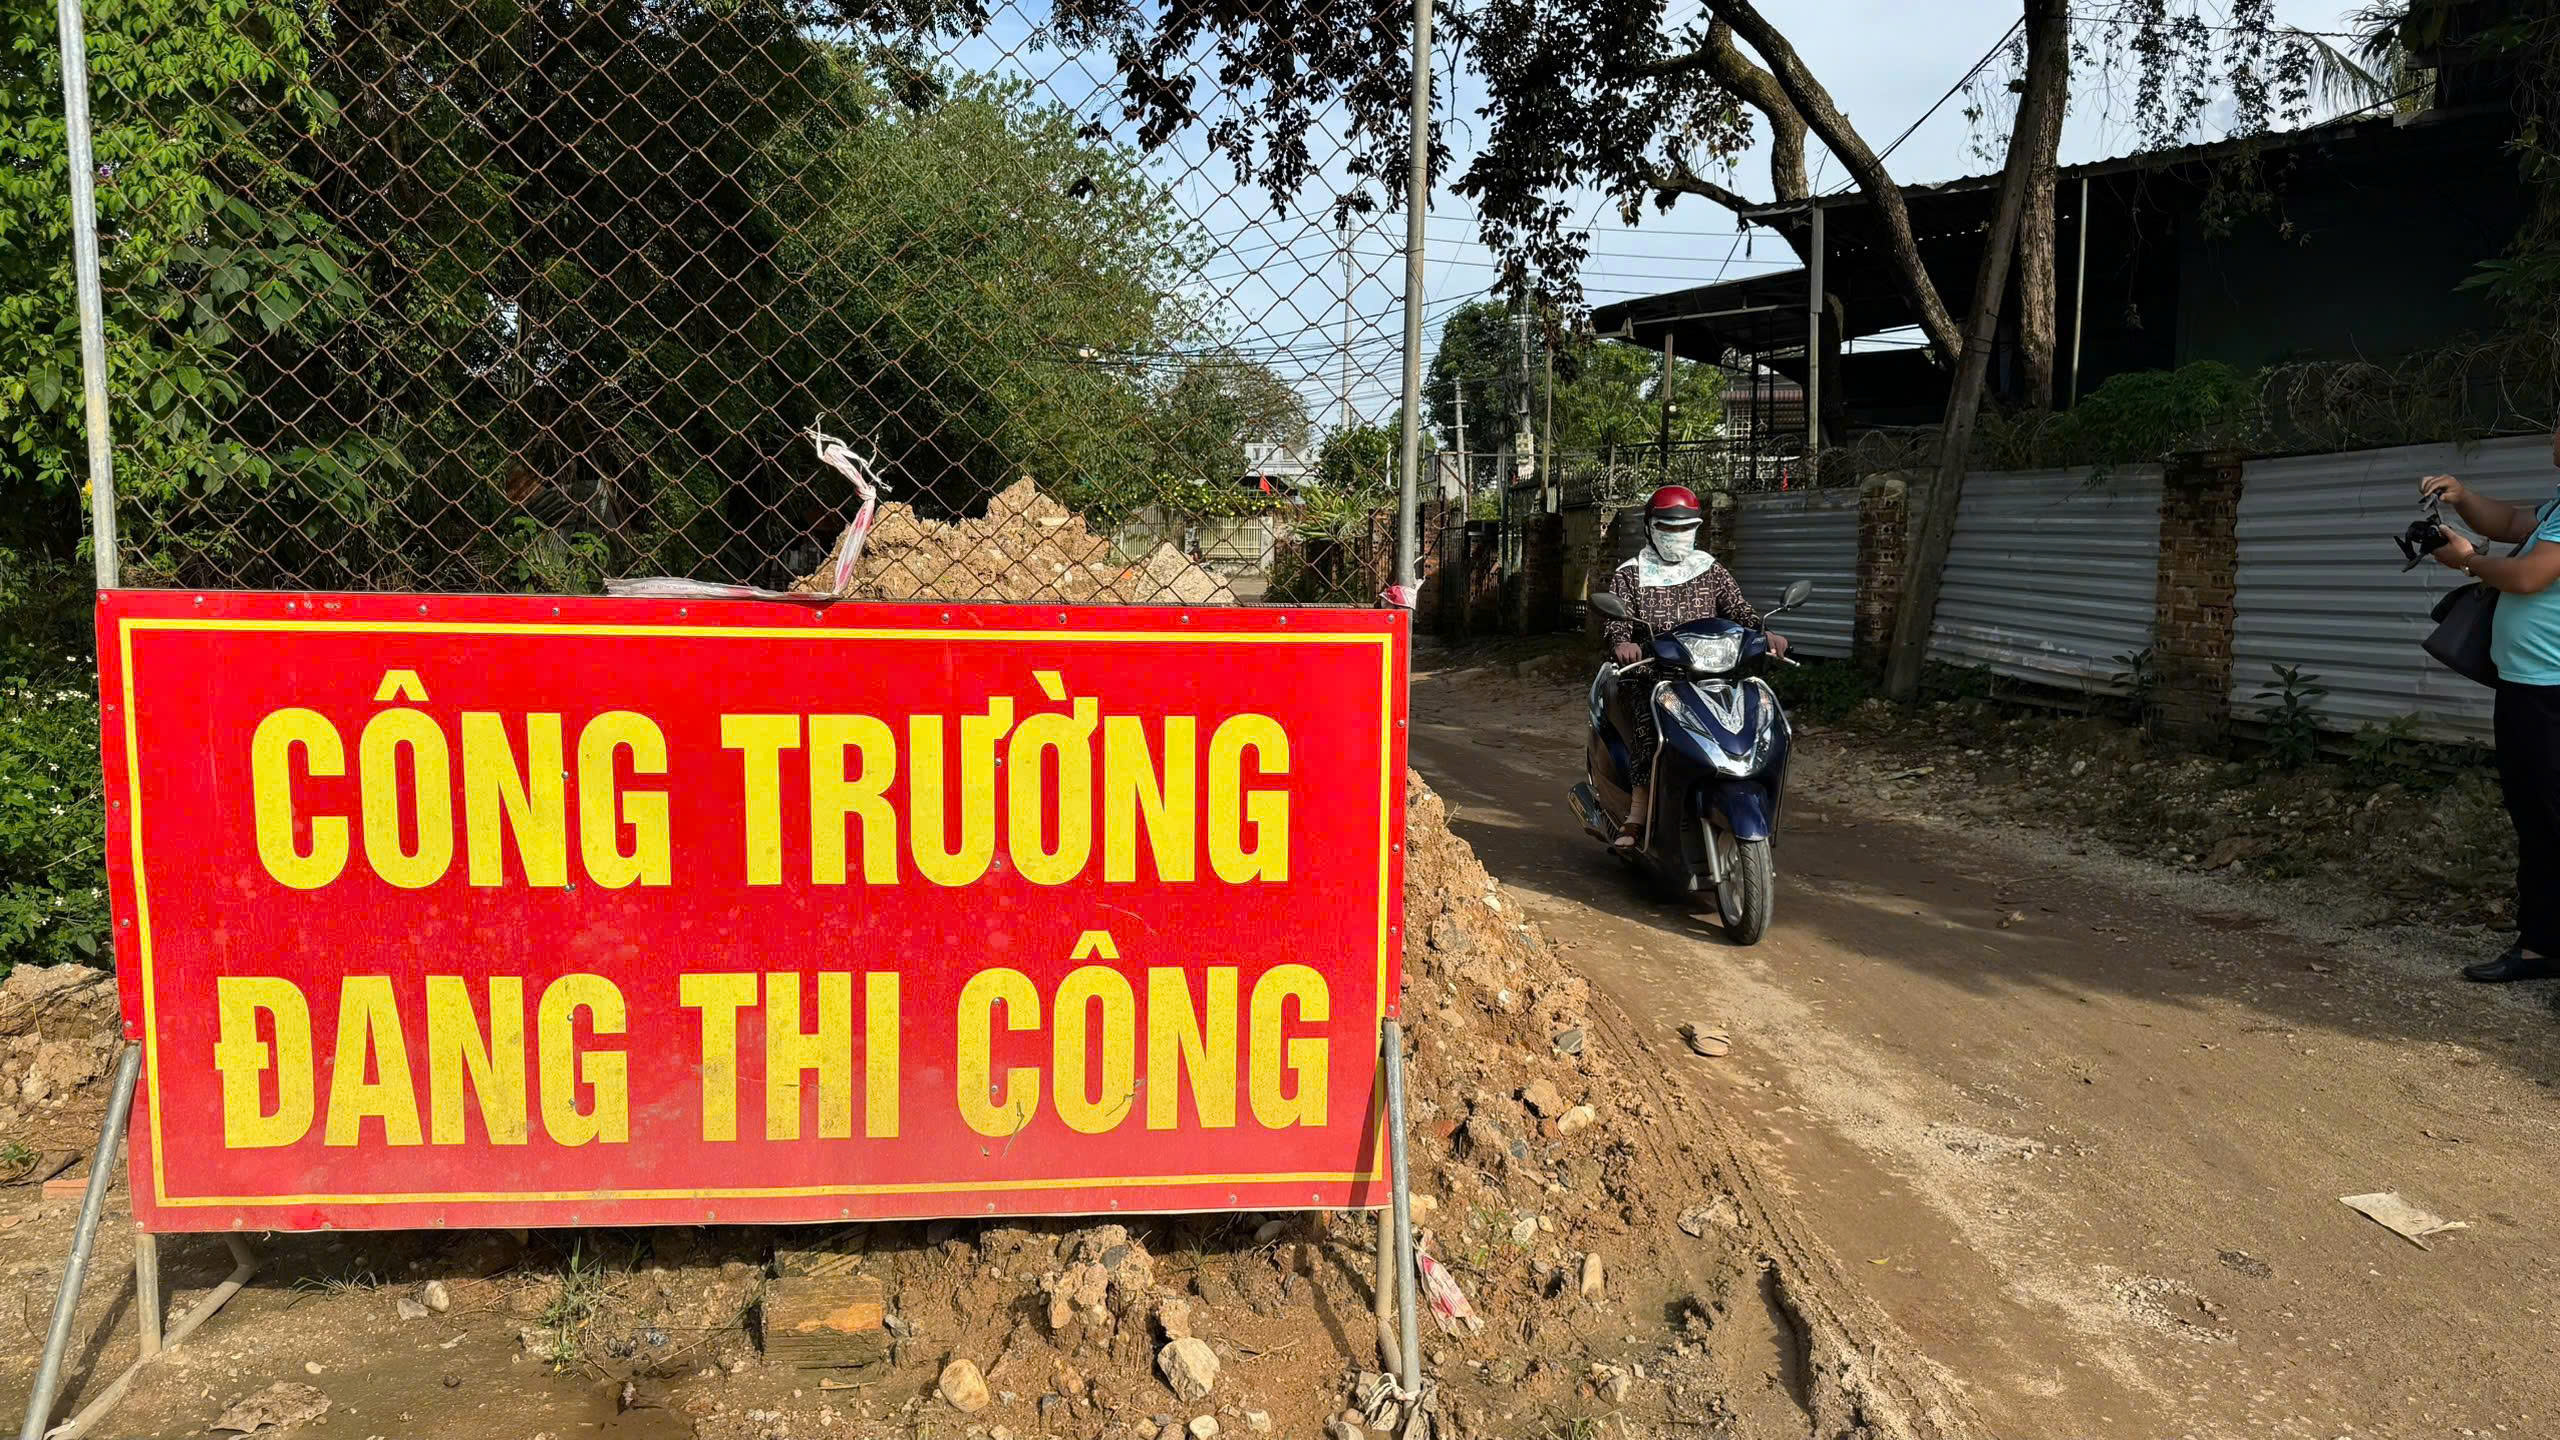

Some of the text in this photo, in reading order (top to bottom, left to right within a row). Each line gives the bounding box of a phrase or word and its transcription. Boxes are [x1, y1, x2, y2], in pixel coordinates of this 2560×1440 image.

[251, 669, 1291, 890] CÔNG TRƯỜNG
[213, 930, 1330, 1149] ĐANG THI CÔNG
